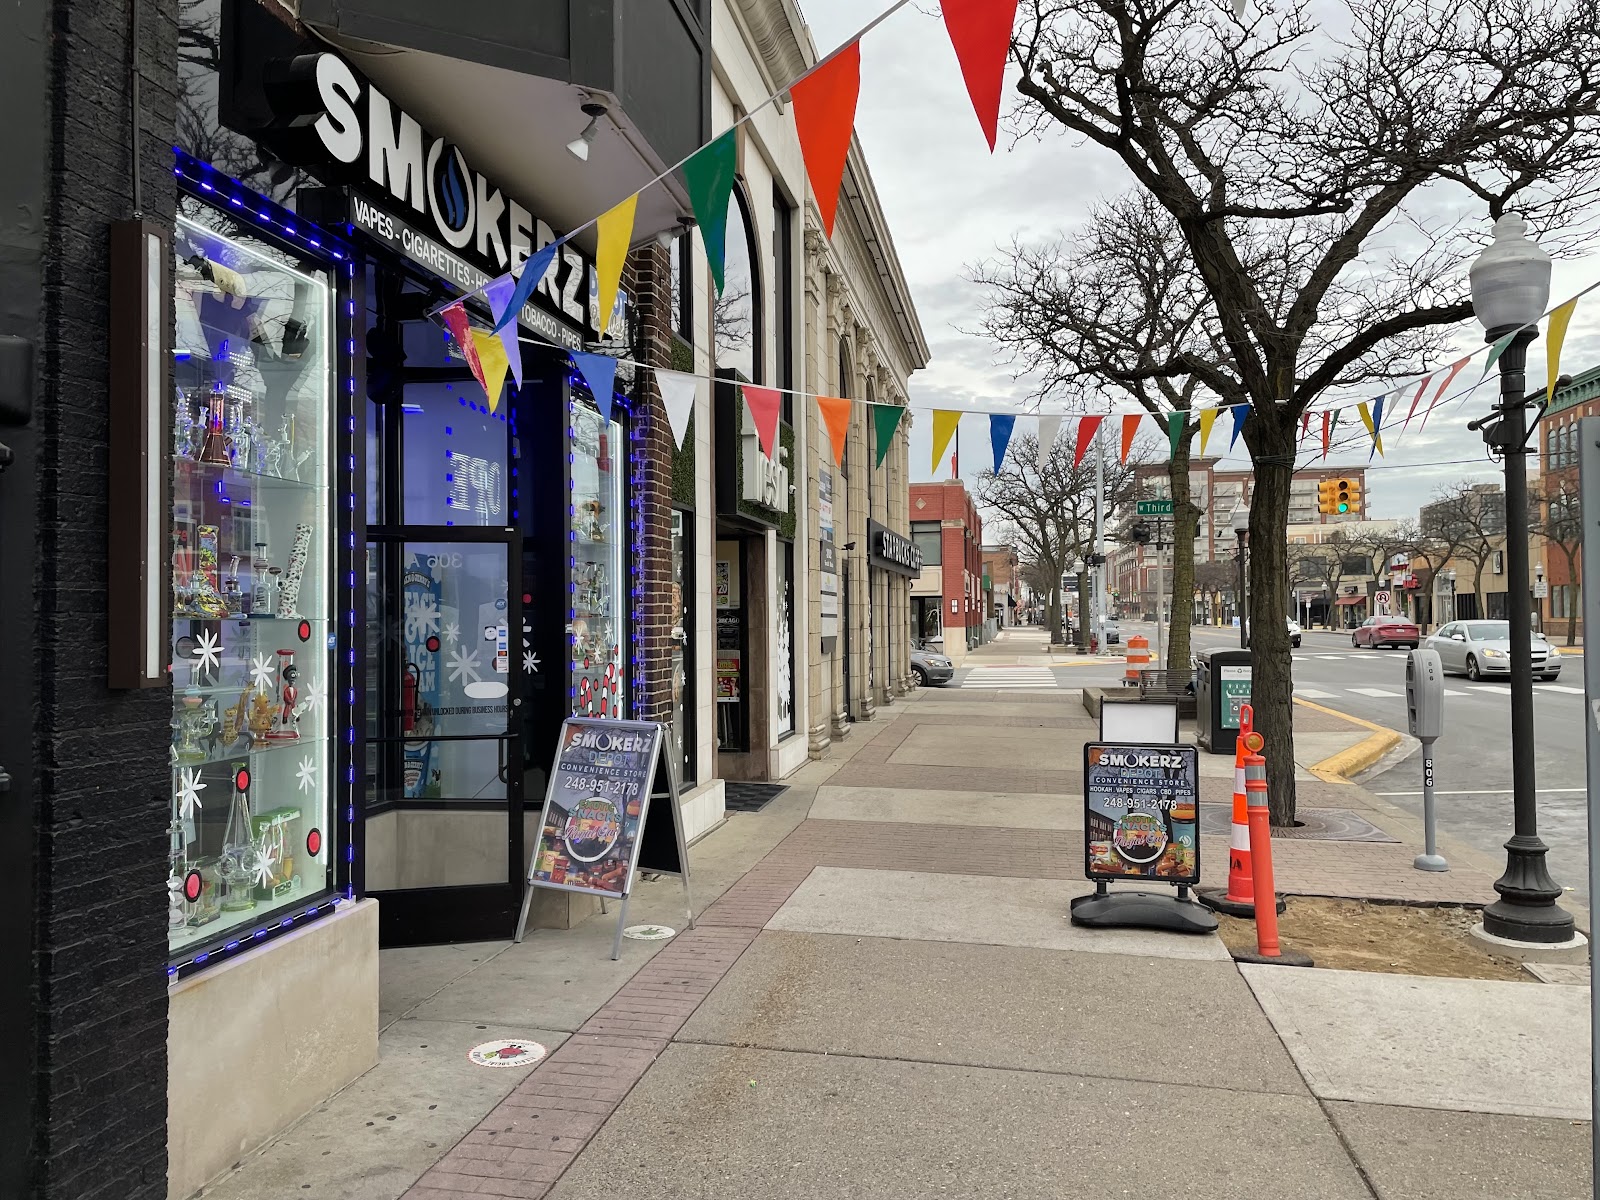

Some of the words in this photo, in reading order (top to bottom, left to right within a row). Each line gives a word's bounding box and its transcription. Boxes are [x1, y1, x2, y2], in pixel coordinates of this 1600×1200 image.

[315, 52, 584, 325] SMOKERZ
[354, 196, 393, 240] VAPES
[402, 229, 470, 286] CIGARETTES
[521, 303, 557, 338] TOBACCO
[561, 328, 581, 351] PIPES
[1146, 503, 1171, 512] Third
[455, 706, 471, 715] DURING
[472, 705, 493, 714] BUSINESS
[494, 704, 508, 713] HOURS
[571, 732, 653, 753] SMOKERZ
[588, 751, 631, 766] DEPOT
[1100, 753, 1183, 768] SMOKERZ
[561, 763, 620, 776] CONVENIENCE
[623, 770, 647, 778] STORE
[1120, 767, 1160, 778] DEPOT
[1425, 759, 1433, 787] 806
[564, 776, 639, 796] 248-951-2178
[1095, 777, 1154, 786] CONVENIENCE
[1089, 785, 1113, 793] HOOKAH
[1115, 786, 1134, 794] VAPES
[1136, 787, 1157, 795] CIGARS
[1160, 788, 1172, 796] CBD
[580, 801, 615, 812] EXOTIC
[1103, 797, 1178, 810] 248-951-2178
[568, 807, 622, 823] SNACKS
[1113, 821, 1168, 832] SNACKS
